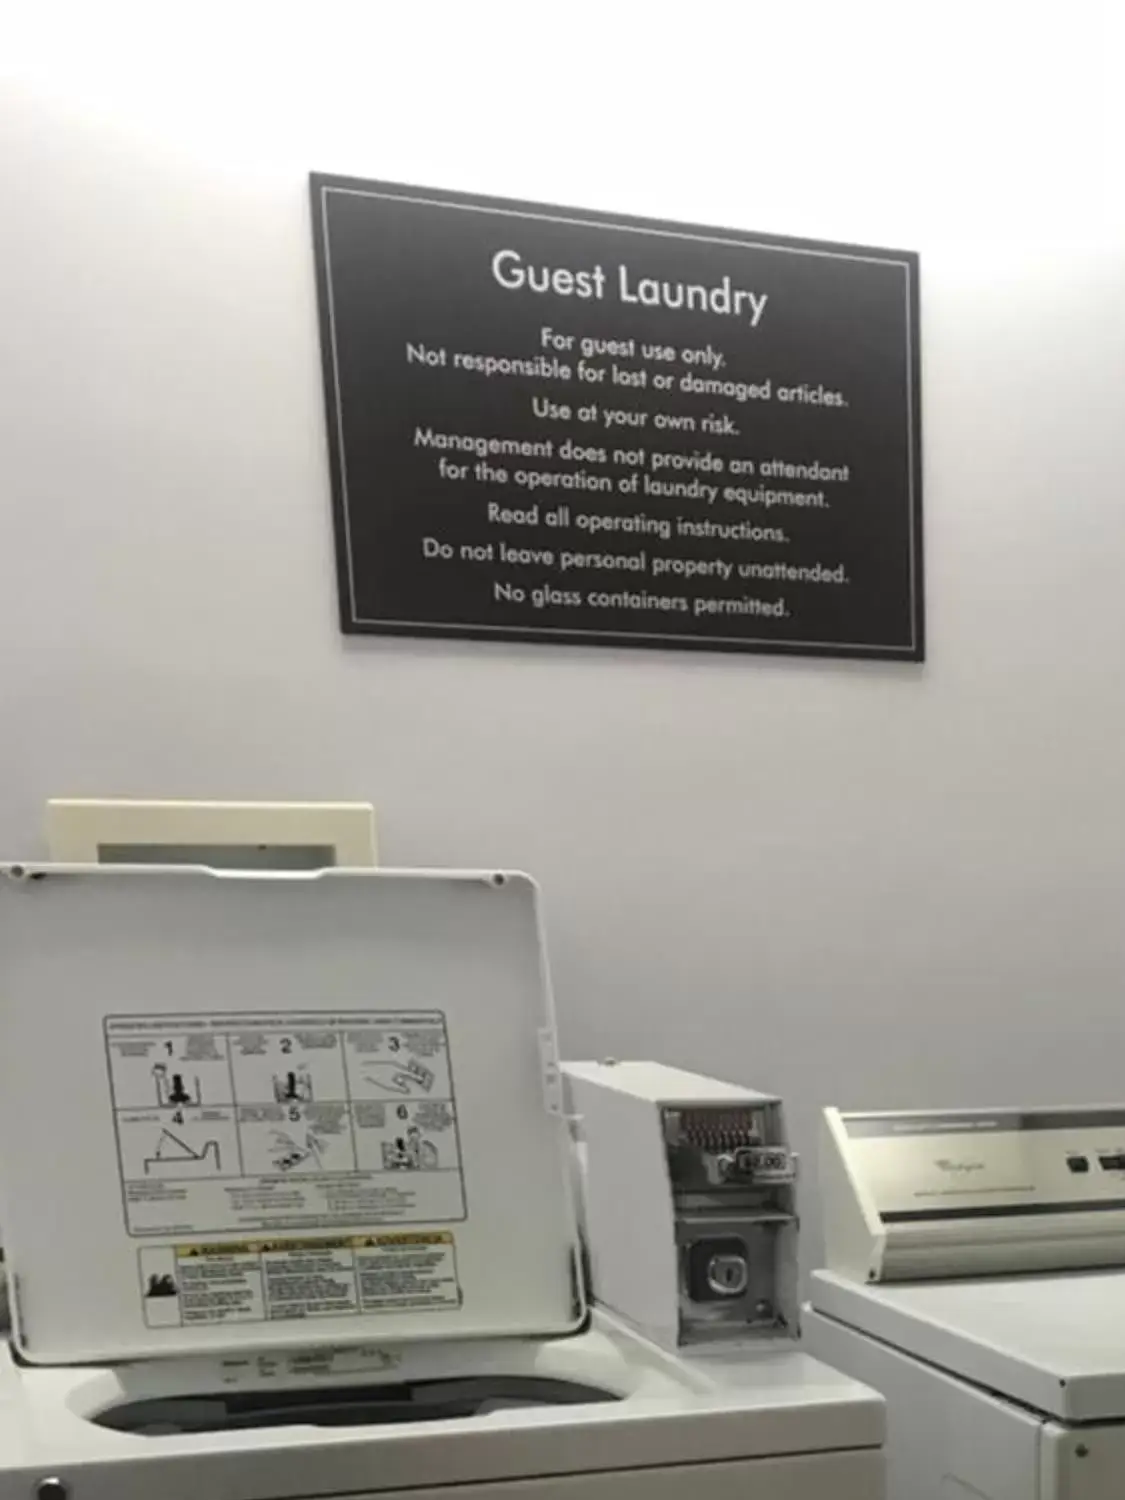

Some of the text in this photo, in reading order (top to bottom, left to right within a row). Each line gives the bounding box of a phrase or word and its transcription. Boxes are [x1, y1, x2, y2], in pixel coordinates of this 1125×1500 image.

[492, 250, 768, 327] Guest Laundry
[541, 327, 726, 370] For guest use only.
[407, 343, 446, 366] Not
[454, 354, 571, 380] responsible
[577, 360, 606, 384] for
[653, 375, 675, 389] or
[680, 372, 771, 402] damaged
[777, 384, 848, 407] articles.
[532, 397, 739, 435] Use at your own risk.
[414, 427, 850, 482] Management does not provide an attendant
[439, 457, 830, 509] for the operation of laundry equipment.
[488, 502, 789, 542] Read all operating instructions.
[423, 537, 848, 584] Do not leave personal property unattended.
[494, 582, 789, 617] No glass containers permitted.
[164, 1039, 174, 1057] 1
[279, 1036, 293, 1055] 2
[387, 1035, 401, 1053] 3
[171, 1109, 185, 1126] 4
[287, 1105, 301, 1122] 5
